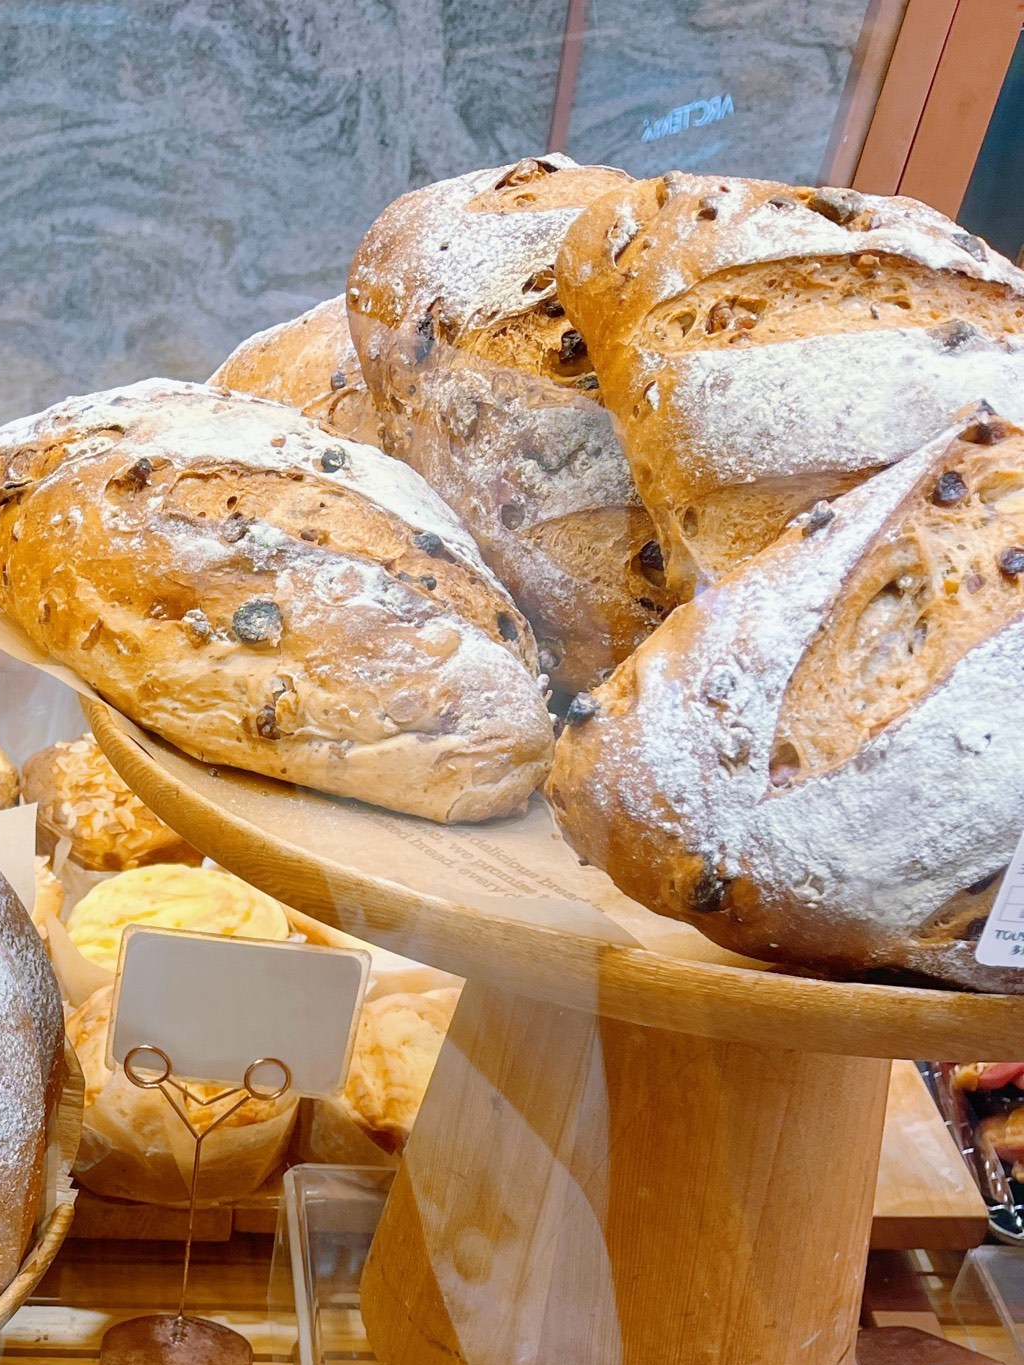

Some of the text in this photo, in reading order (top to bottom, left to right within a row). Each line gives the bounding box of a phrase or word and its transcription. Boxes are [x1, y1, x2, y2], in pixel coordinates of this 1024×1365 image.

[408, 836, 458, 869] bread,
[458, 867, 506, 893] every
[469, 837, 540, 880] delicious
[469, 859, 538, 895] promise
